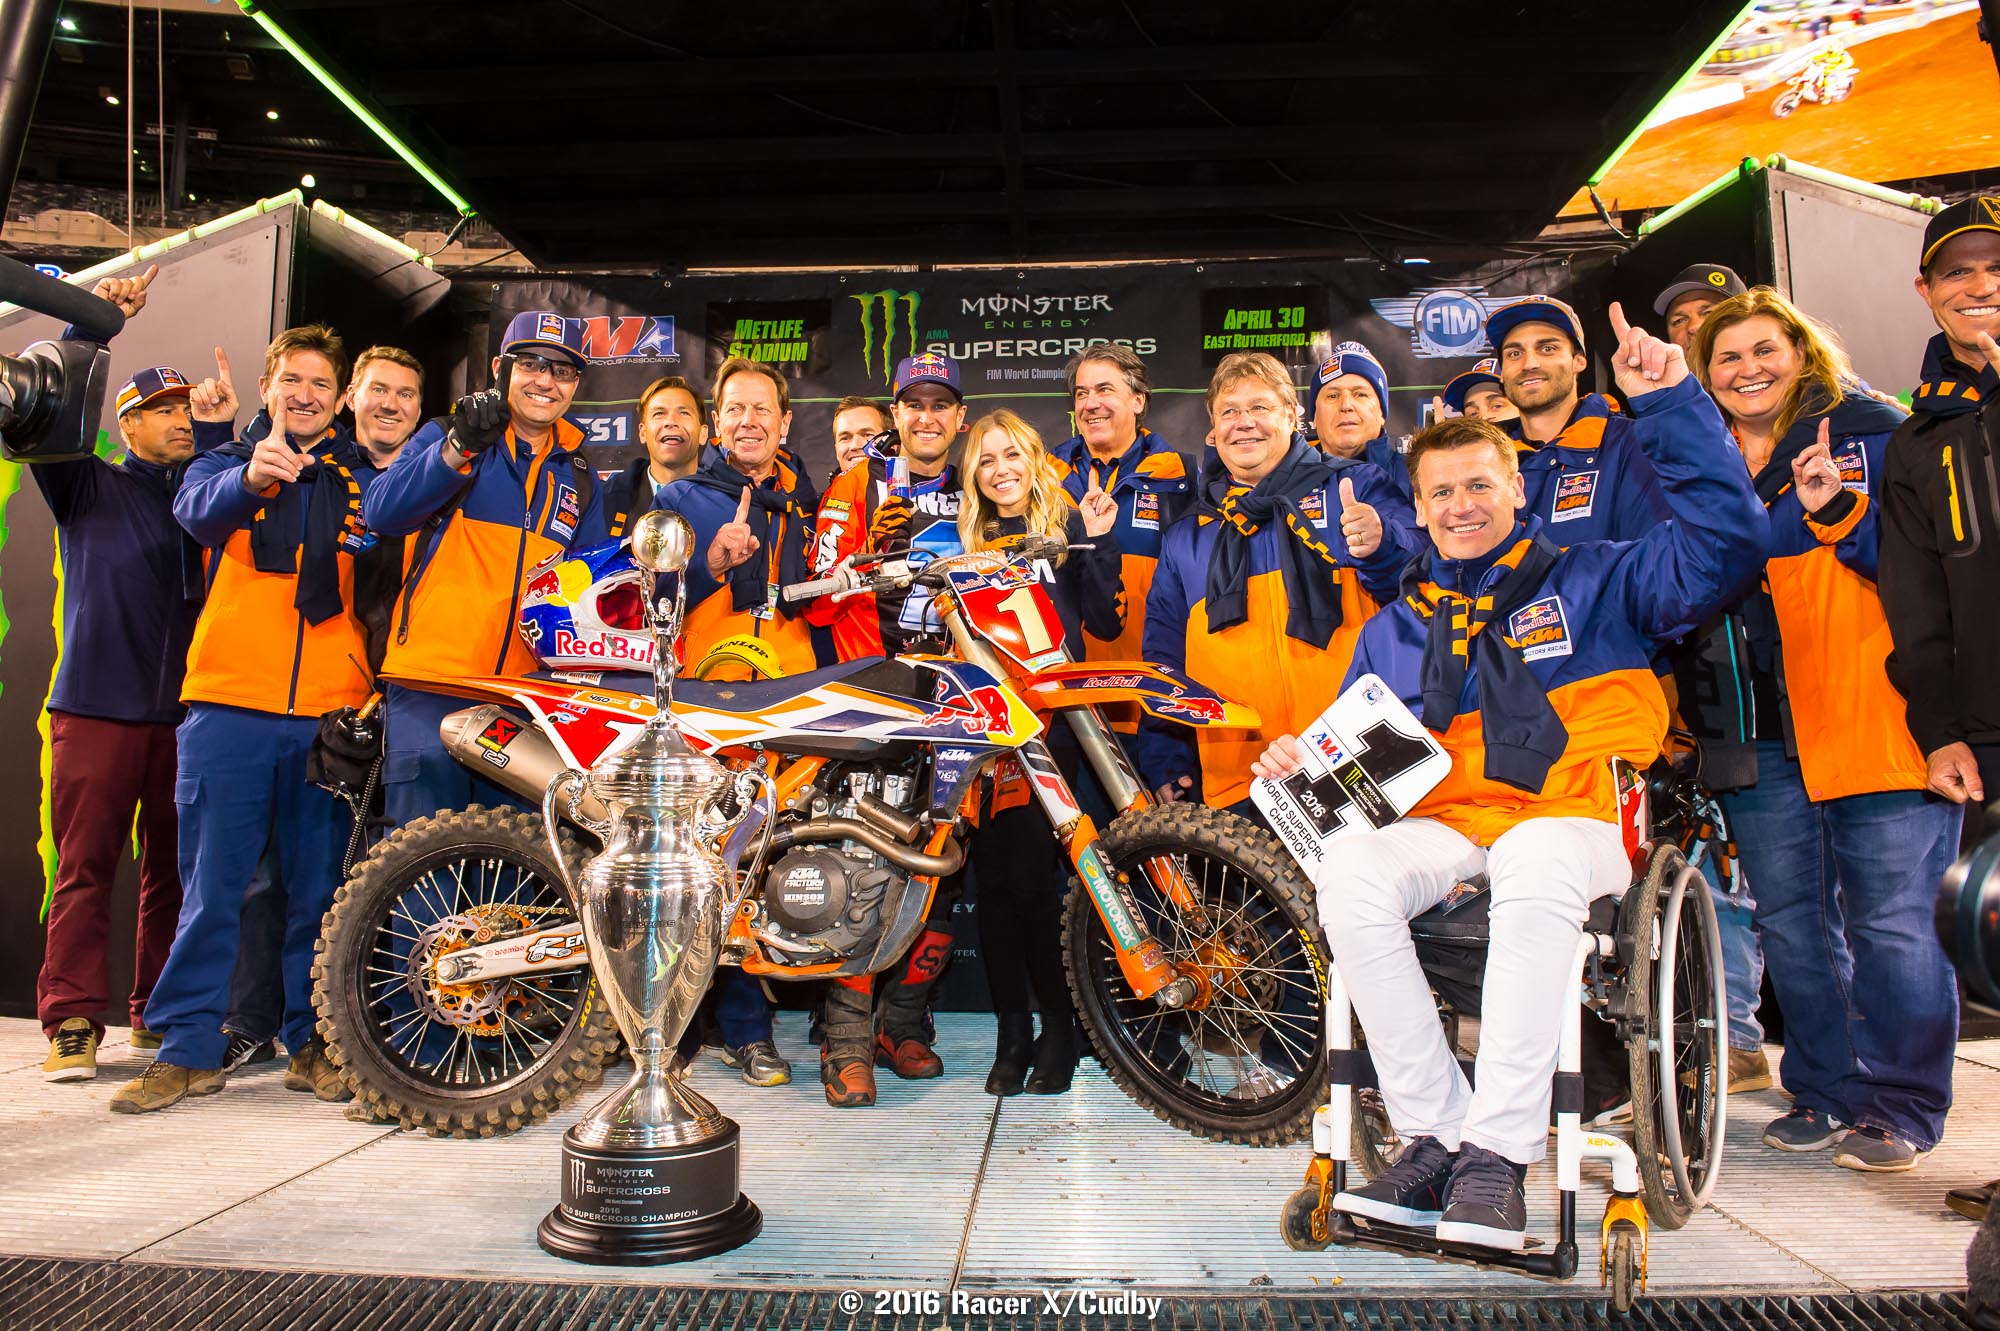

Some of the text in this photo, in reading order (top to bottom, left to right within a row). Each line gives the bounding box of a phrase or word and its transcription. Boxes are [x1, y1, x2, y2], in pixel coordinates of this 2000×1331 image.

[961, 293, 1114, 317] MONSTER
[984, 318, 1091, 330] ENERGY
[1224, 307, 1305, 330] APRIL 30
[1426, 305, 1478, 336] FIM
[565, 316, 681, 358] MA
[734, 319, 804, 340] METLIFE
[925, 329, 950, 340] AMA
[1203, 335, 1233, 349] EAST
[728, 342, 809, 362] STADIUM
[910, 365, 949, 379] Red Bull
[987, 368, 1066, 381] FIM World Champio
[1559, 484, 1592, 497] Red Bull
[1556, 495, 1589, 510] KTM
[997, 585, 1053, 656] 1
[1516, 611, 1560, 635] Red Bull
[1521, 627, 1562, 648] KTM
[555, 630, 656, 664] Red Bul
[711, 641, 769, 658] DUNLOP
[1527, 644, 1567, 656] CTORY RACING
[1083, 675, 1144, 688] Red Bull
[589, 694, 611, 703] 450
[1311, 732, 1343, 765] AMA
[1261, 778, 1289, 811] WORLD
[1300, 790, 1326, 818] 2016
[1270, 808, 1309, 859] CHAMPION
[788, 868, 820, 879] KTM
[784, 879, 824, 887] FACTORY
[1093, 877, 1137, 946] MOTOREX
[494, 945, 525, 957] brembo
[597, 1167, 654, 1178] MONSTER
[586, 1186, 671, 1196] SUPERCROSS
[574, 1209, 638, 1223] SUPERCROSS
[641, 1209, 698, 1223] CHAMPION
[600, 1206, 621, 1214] 2016
